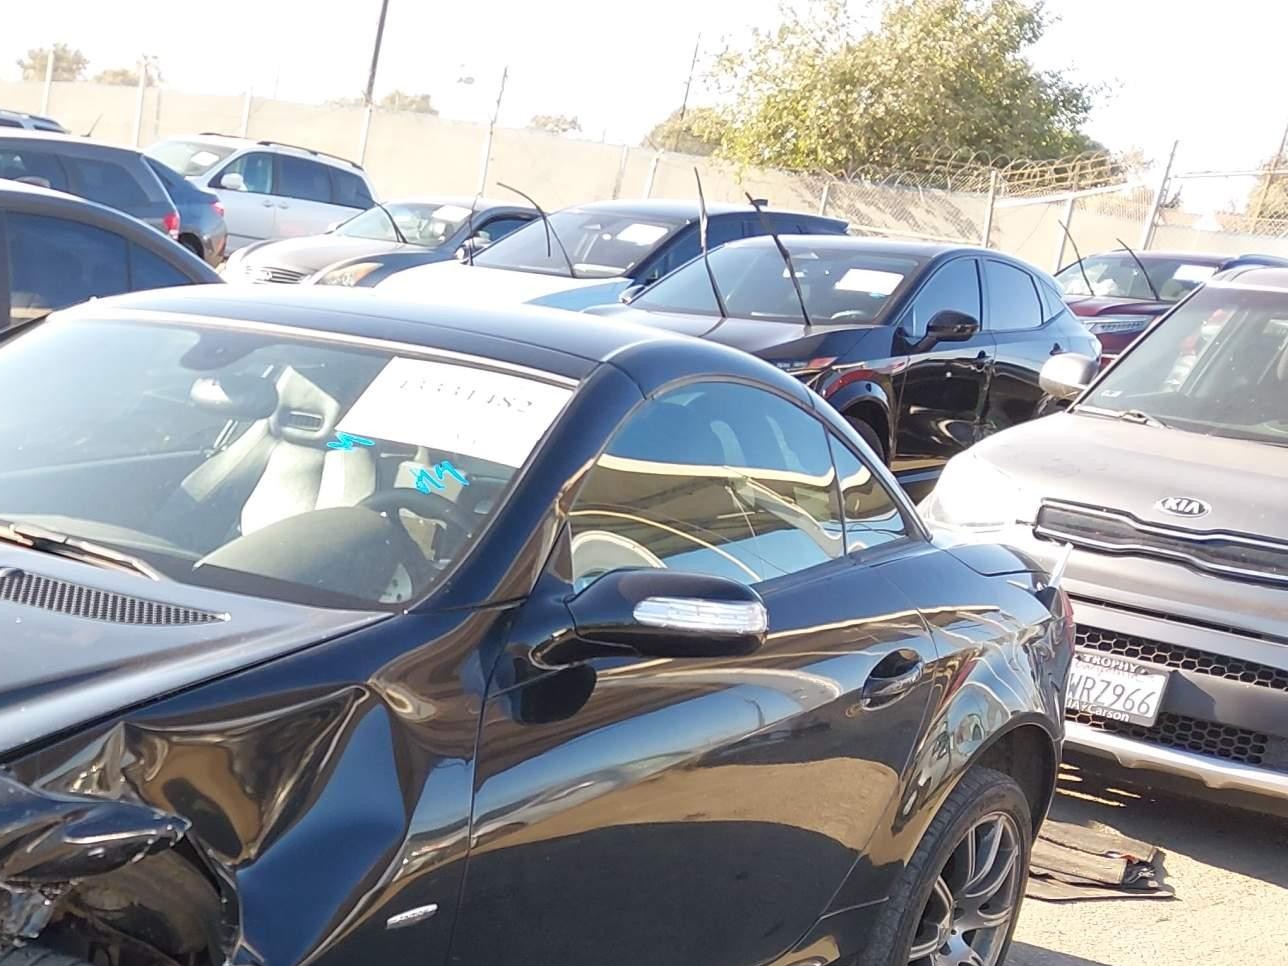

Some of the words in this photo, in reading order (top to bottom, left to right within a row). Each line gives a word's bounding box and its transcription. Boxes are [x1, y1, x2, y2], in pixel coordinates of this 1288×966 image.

[1163, 496, 1201, 515] KIA
[1082, 654, 1139, 673] TROPHY
[1087, 703, 1130, 722] Carson
